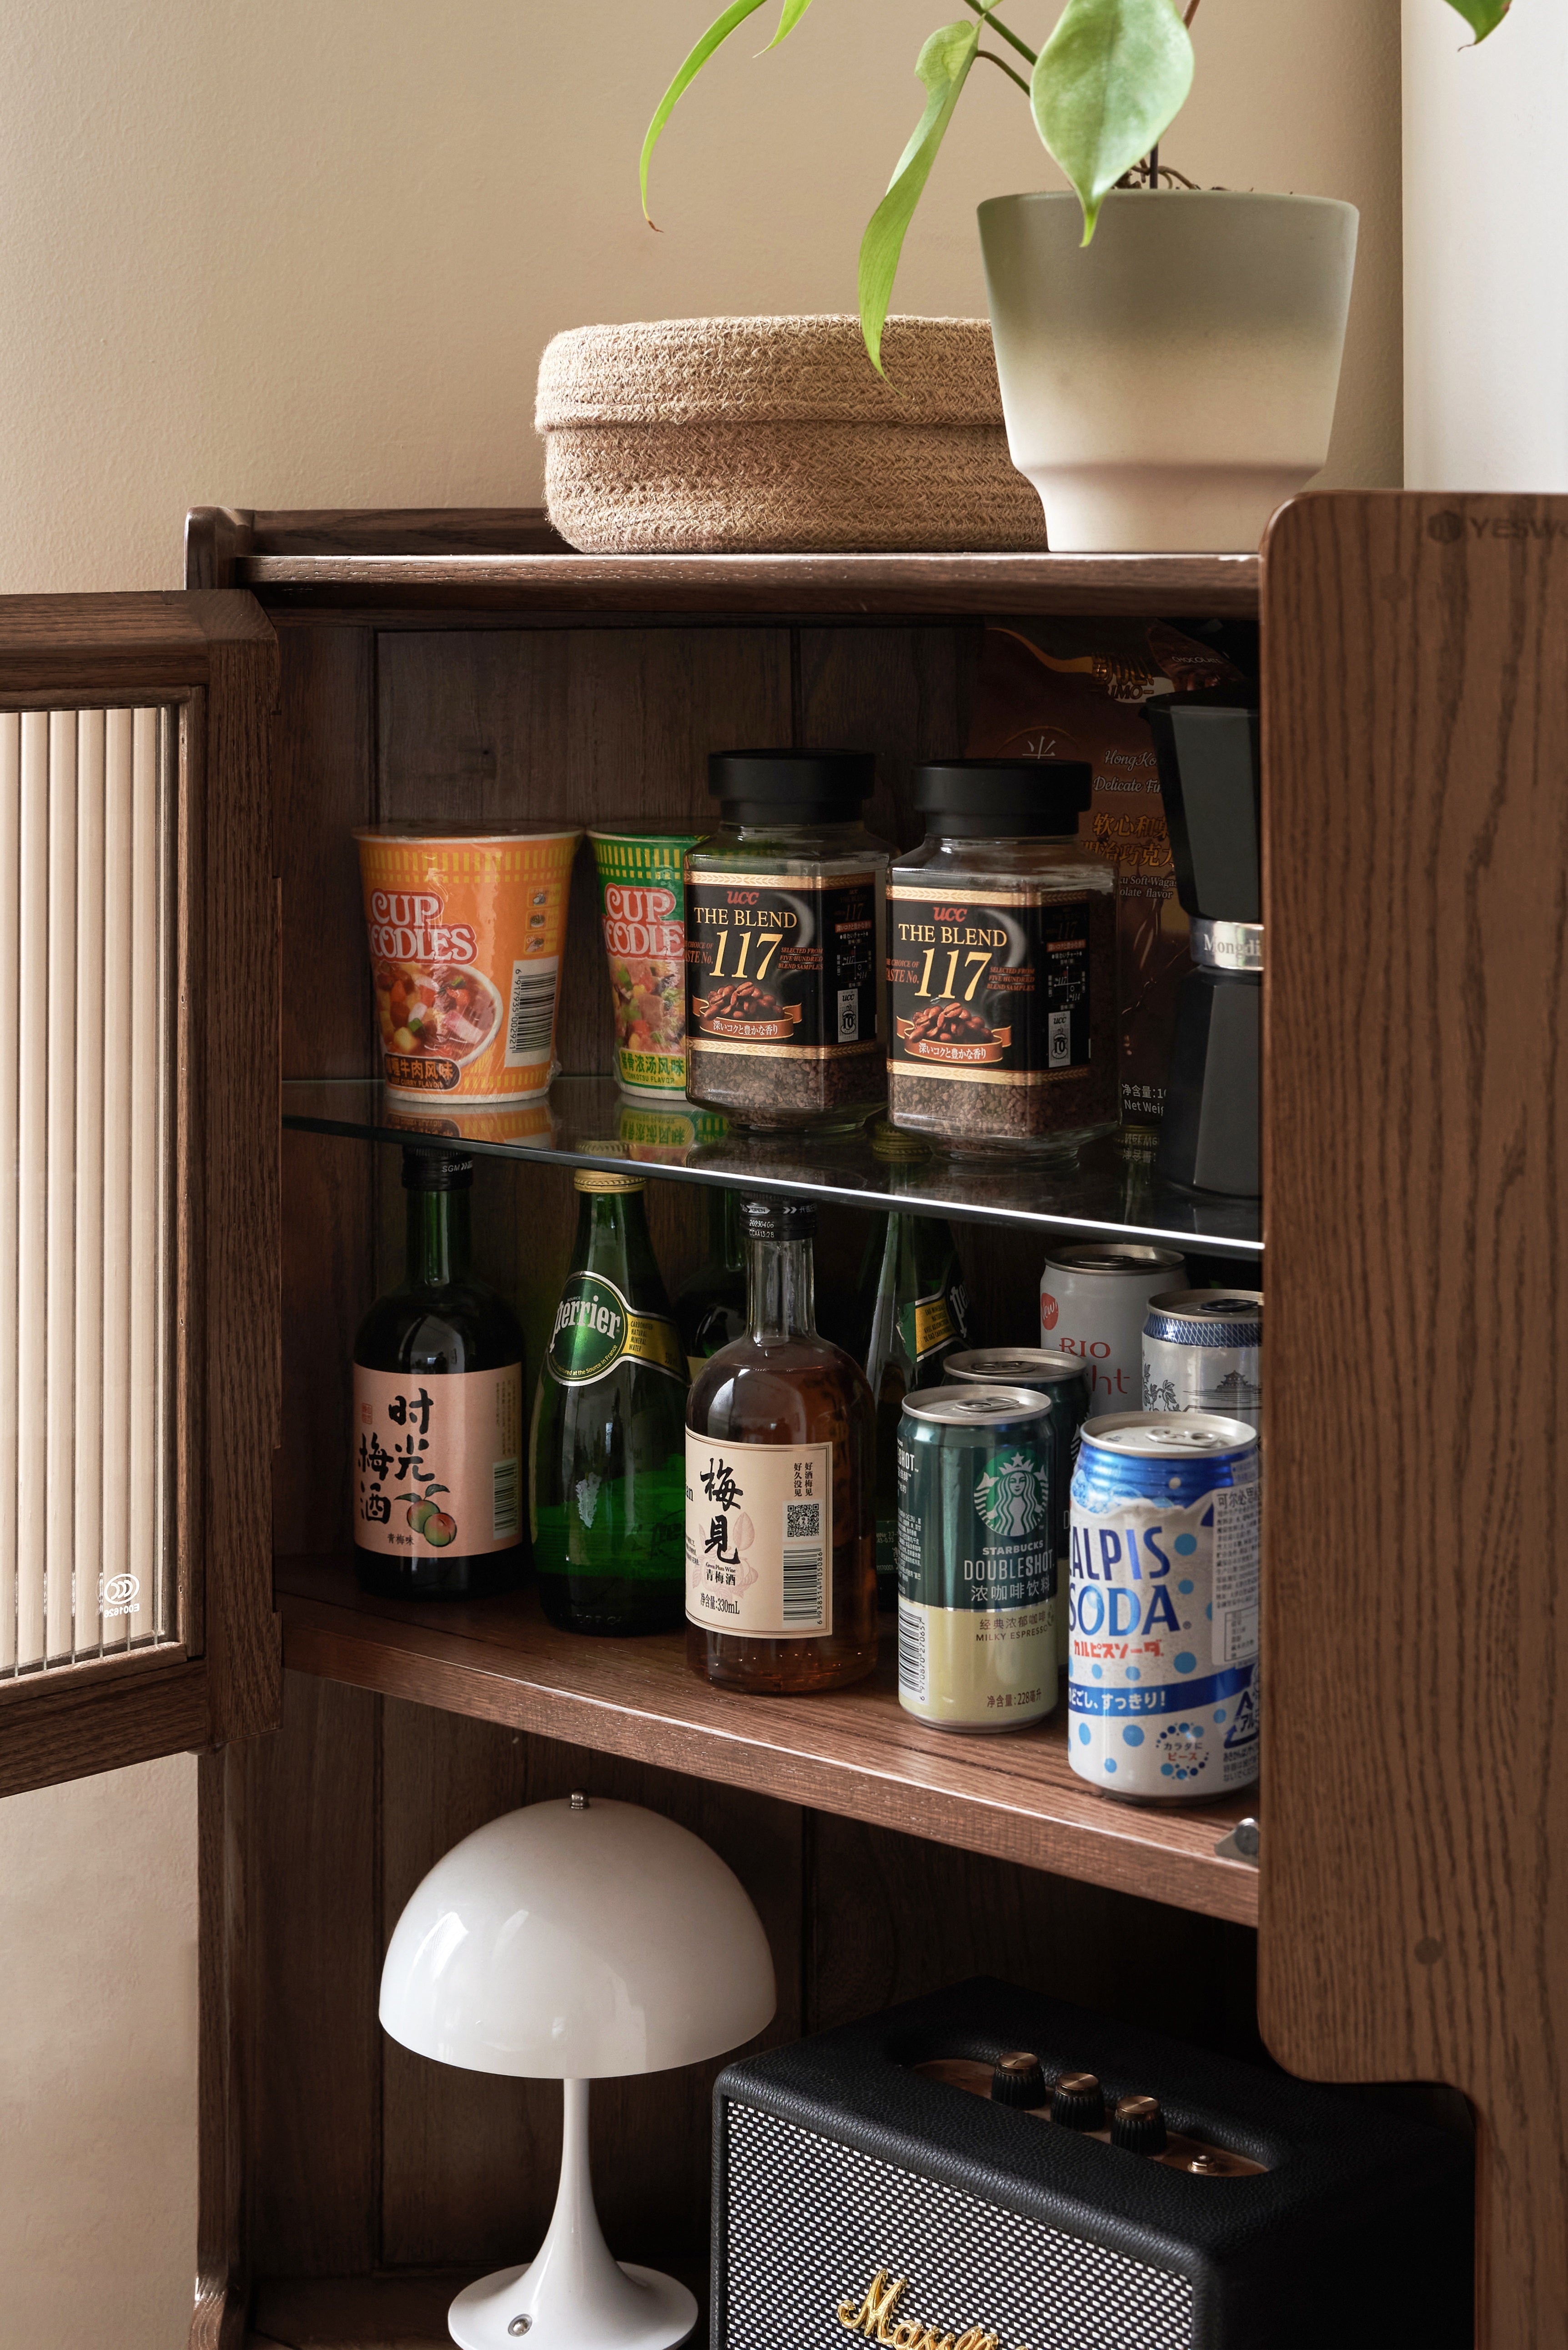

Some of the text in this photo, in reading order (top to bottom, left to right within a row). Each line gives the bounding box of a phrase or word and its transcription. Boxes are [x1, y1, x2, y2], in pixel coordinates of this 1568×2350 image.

[1105, 749, 1157, 771] HongKo
[1093, 775, 1143, 792] Delicate
[1146, 888, 1173, 899] flavor
[372, 892, 439, 926] CUP
[607, 888, 670, 922] CUP
[694, 907, 797, 928] THE BLEND
[898, 924, 1007, 946] THE BLEND
[683, 950, 713, 964] ASTE No.
[709, 929, 783, 980] 117
[892, 959, 910, 967] CHOICE
[905, 970, 920, 984] No.
[914, 948, 992, 1001] 117
[513, 979, 522, 1012] 917935
[509, 1017, 518, 1049] 002921
[713, 1020, 778, 1035] 深いコクと豊かな香り
[919, 1042, 986, 1059] 深いコクと豊かな香り
[401, 1079, 417, 1087] CURRY
[418, 1080, 442, 1088] FLAVOR
[1124, 1099, 1141, 1111] Net
[631, 1321, 653, 1330] CARBONATED
[631, 1329, 647, 1337] NATURAL
[628, 1344, 642, 1352] WATER
[631, 1336, 646, 1346] MINERAL
[1059, 1337, 1111, 1358] RIO
[586, 1362, 602, 1373] Source
[605, 1344, 618, 1361] France
[389, 1387, 435, 1482] 时光
[358, 1432, 394, 1524] 梅酒
[794, 1463, 802, 1497] 好久没见
[804, 1462, 813, 1496] 好酒梅见
[387, 1533, 415, 1546] 青梅味
[982, 1540, 1044, 1555] STARBUCKS
[1070, 1526, 1171, 1581] ALPIS
[706, 1568, 736, 1586] 青梅酒
[971, 1574, 1050, 1602] 浓咖啡饮料
[700, 1592, 740, 1614] 净含量:330mL
[1069, 1583, 1180, 1636] SODA
[980, 1610, 1045, 1630] 经典浓郁咖啡
[976, 1624, 1048, 1642] MILKY ESPRESSO
[1074, 1639, 1162, 1659] カルピスソーダ
